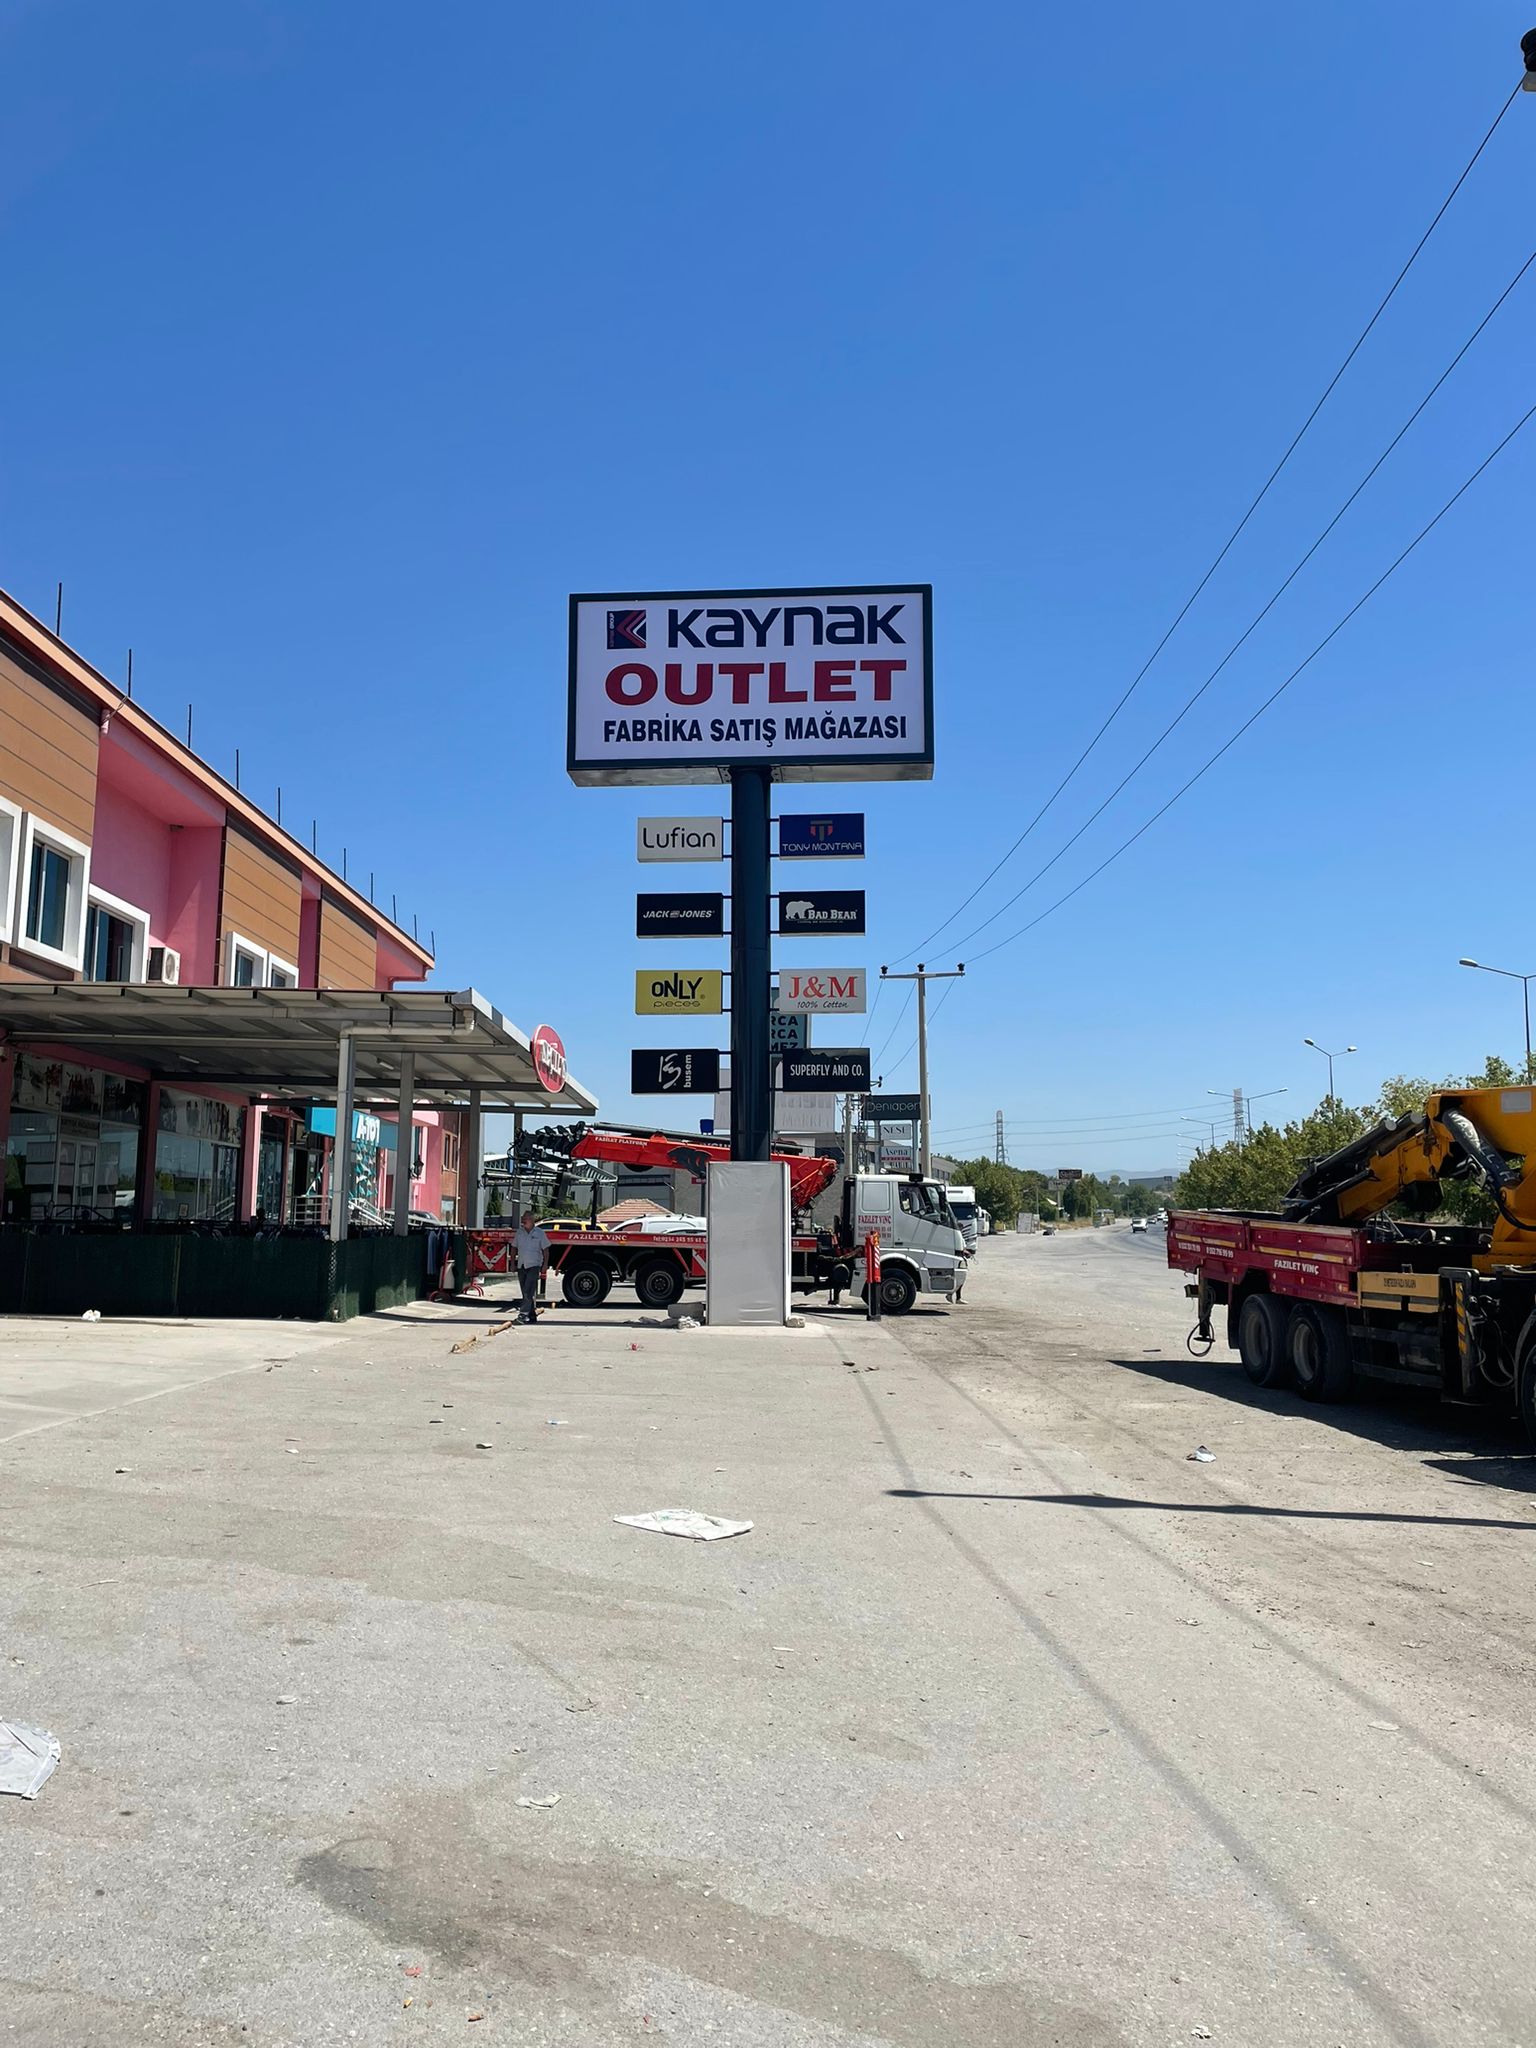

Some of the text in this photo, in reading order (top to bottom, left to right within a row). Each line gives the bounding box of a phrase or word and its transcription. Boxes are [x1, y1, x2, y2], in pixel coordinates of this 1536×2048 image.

[605, 660, 907, 706] OUTLET
[604, 710, 907, 748] FABRİKA SATIŞ MAĞAZASI
[643, 826, 716, 849] Lufian
[782, 842, 862, 852] TONY MONTANA
[643, 910, 670, 918] JACK
[680, 910, 712, 918] JONES
[808, 909, 857, 919] BAD BEAR
[652, 972, 703, 1000] ONLY
[788, 976, 859, 998] J&M
[770, 1015, 798, 1026] RCA
[770, 1029, 798, 1039] RCA
[790, 1064, 864, 1076] SUPERFLY AND CO.
